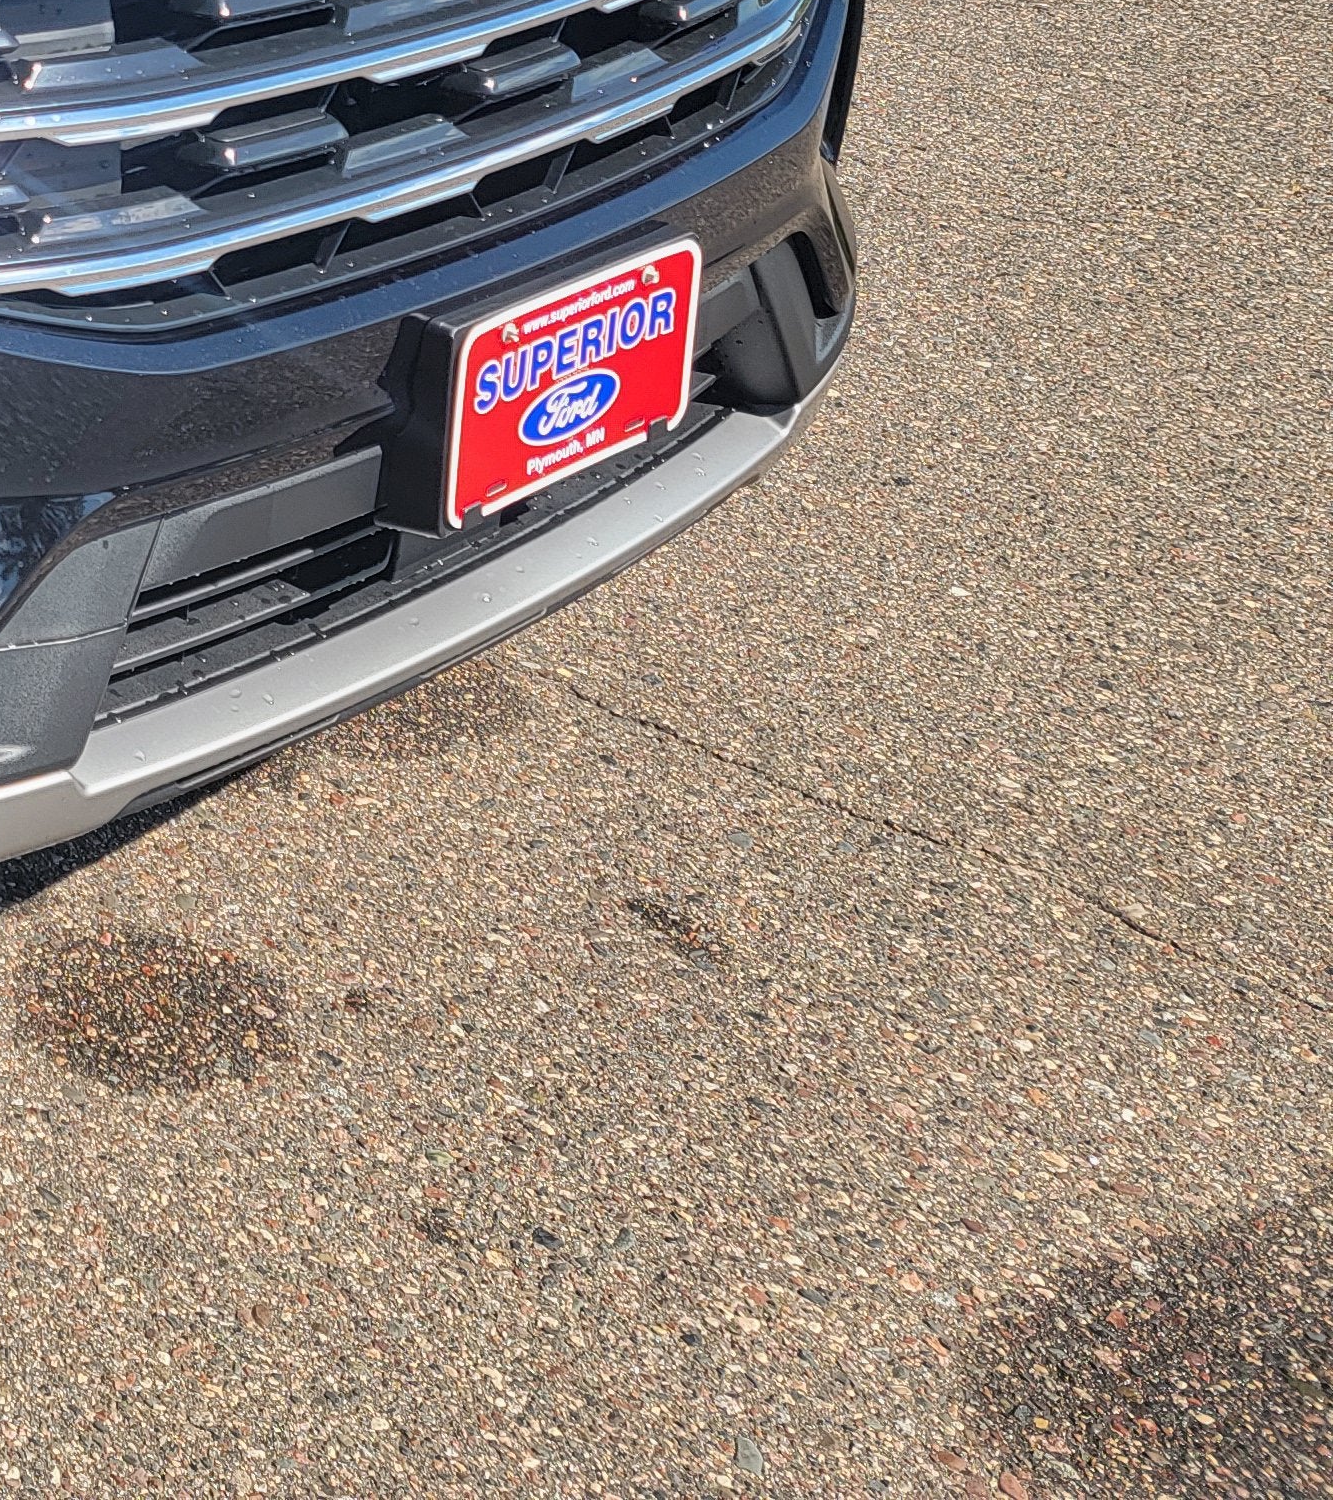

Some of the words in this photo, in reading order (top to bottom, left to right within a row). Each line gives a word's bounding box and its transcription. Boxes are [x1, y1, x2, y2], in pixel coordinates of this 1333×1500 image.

[522, 278, 636, 335] www.superiorford.com
[473, 286, 677, 415] SUPERIOR
[538, 378, 604, 436] Ford
[526, 438, 585, 476] Plymouth,
[584, 426, 606, 449] MN
